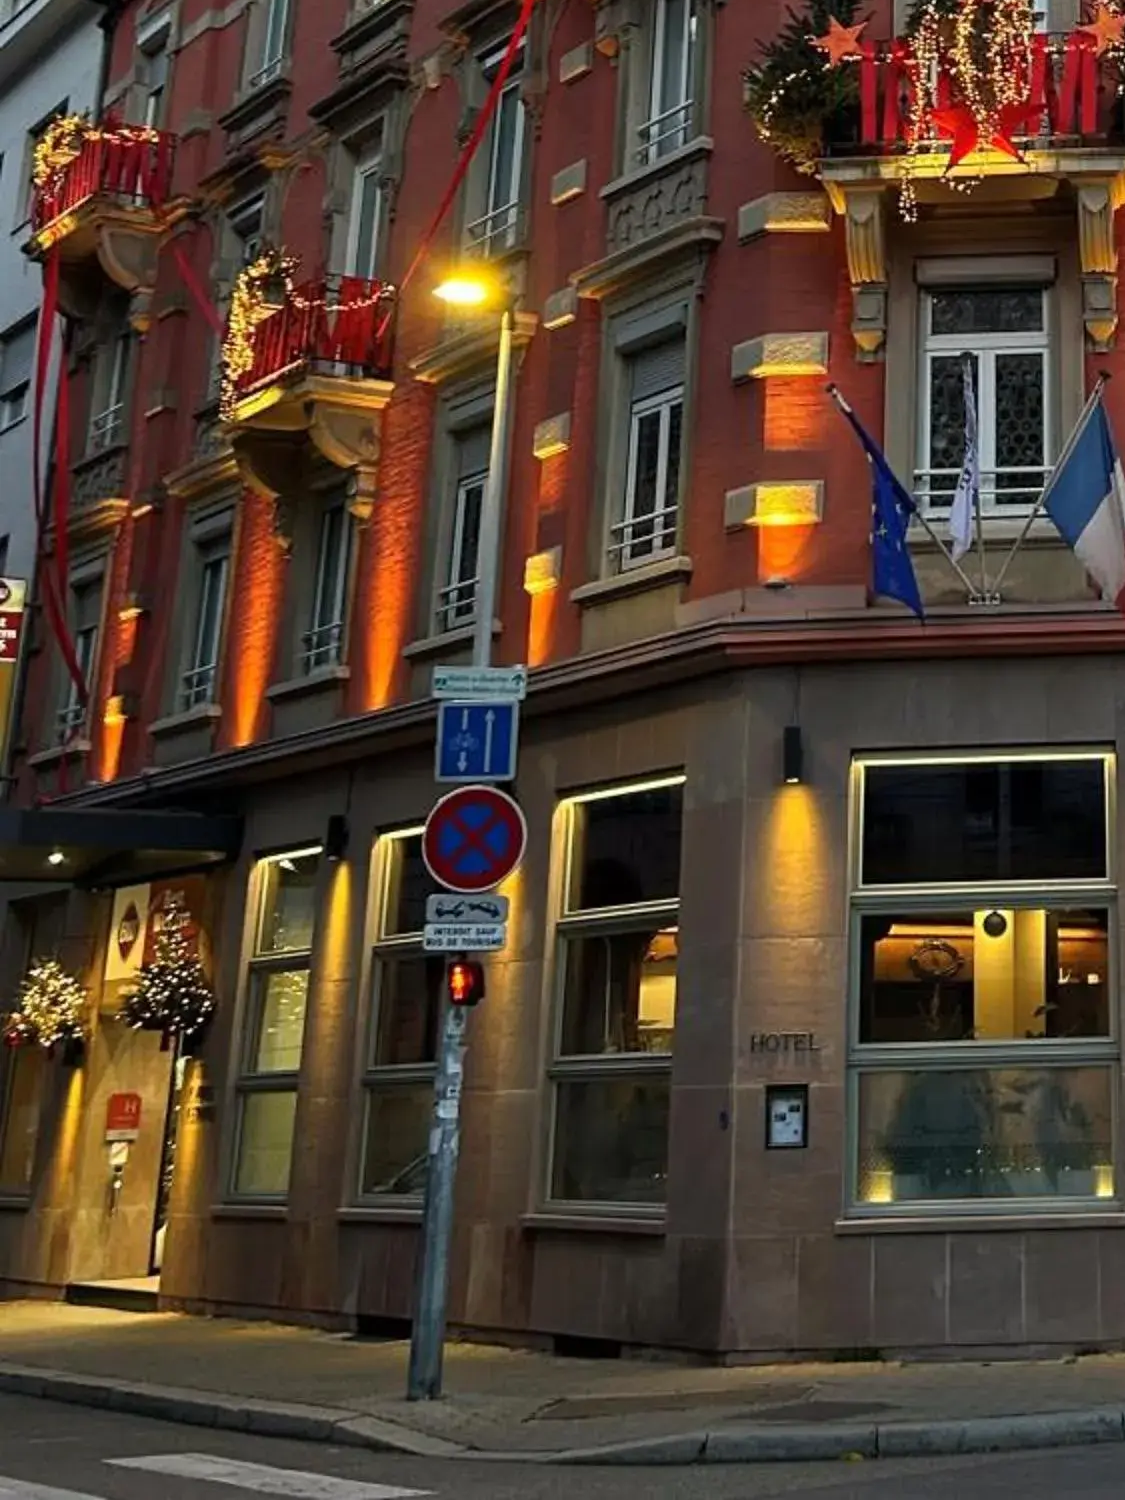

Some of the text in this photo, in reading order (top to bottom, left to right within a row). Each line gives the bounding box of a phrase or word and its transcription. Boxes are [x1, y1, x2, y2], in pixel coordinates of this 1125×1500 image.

[432, 927, 472, 936] INTERDIT
[425, 938, 443, 947] BUS
[446, 938, 457, 946] DE
[751, 1033, 820, 1052] HOTEL
